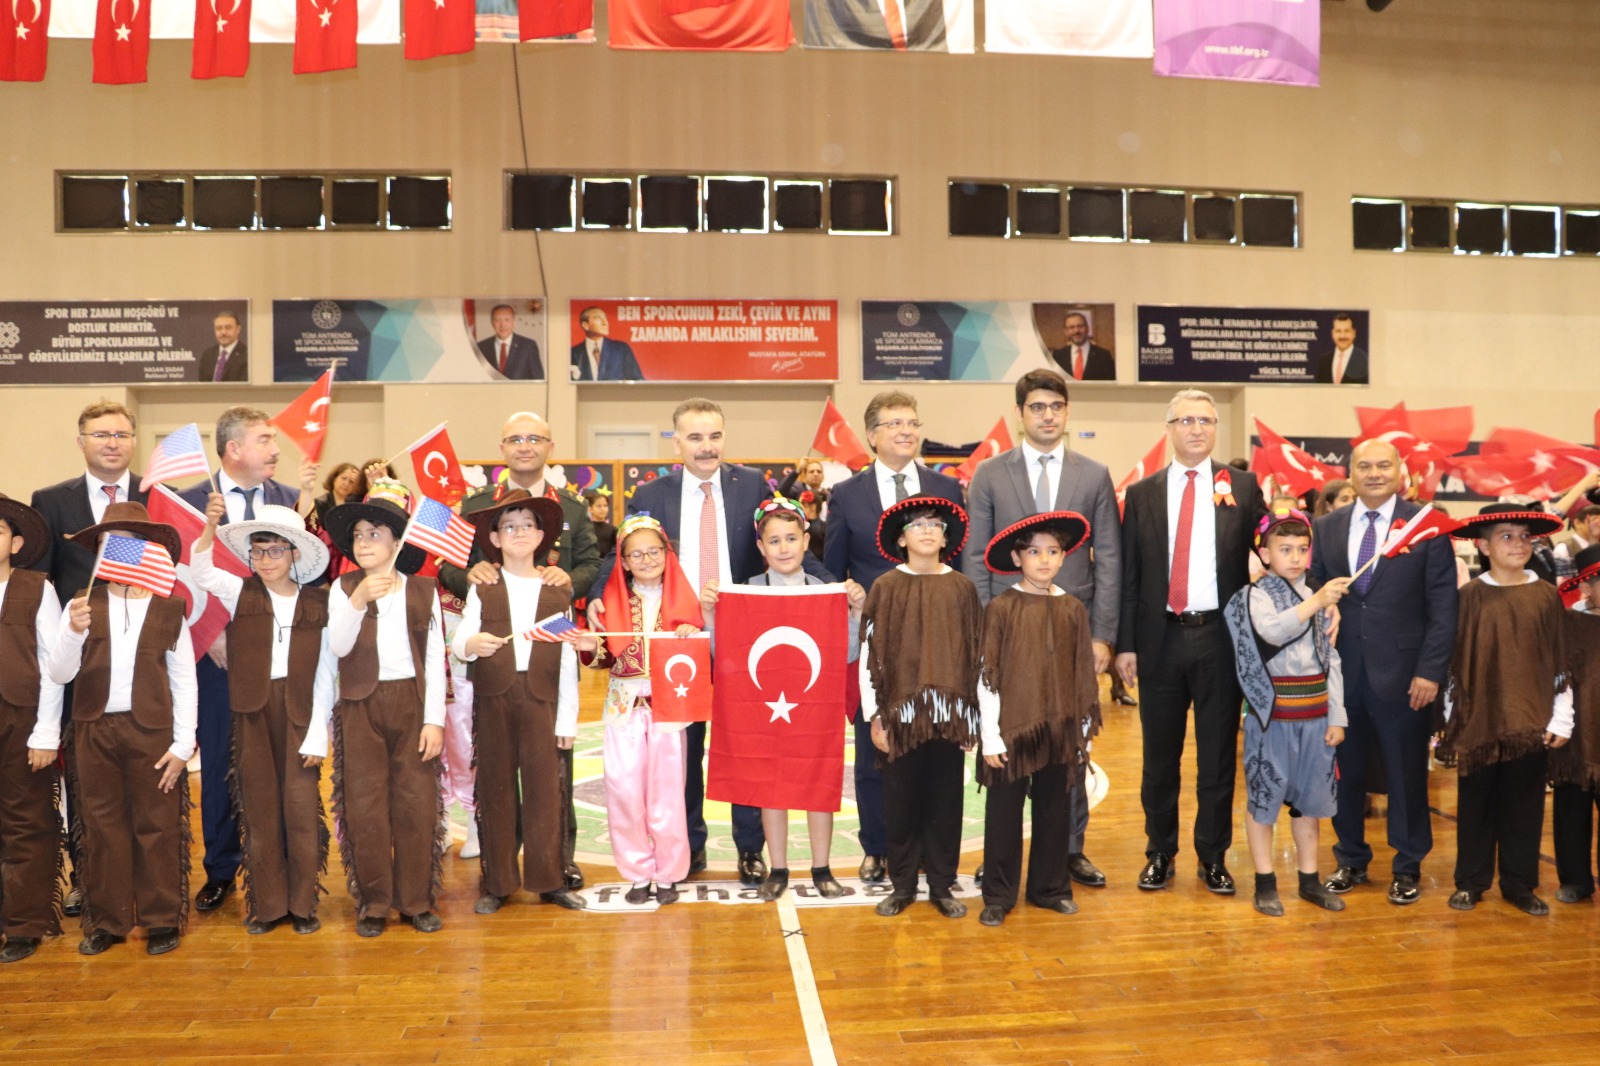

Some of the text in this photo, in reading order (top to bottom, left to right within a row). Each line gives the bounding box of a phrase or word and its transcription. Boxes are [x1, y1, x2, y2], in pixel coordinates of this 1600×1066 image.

[45, 305, 179, 320] SPOR HER ZAMAN HOŞGÖRÜ VE
[617, 302, 831, 325] BEN SPORCUNUN ZEKİ, ÇEVİK VE AYNI
[68, 320, 156, 333] DOSTLUK DEMEKTİR.
[1263, 319, 1272, 328] VE
[630, 323, 818, 342] ZAMANDA AHLAKLISINI SEVERİM.
[1234, 329, 1261, 339] KATILAN
[52, 335, 173, 348] BÜTÜN SPORCULARIMIZA VE
[1244, 341, 1253, 350] VE
[29, 348, 196, 364] GÖREVLİLERİMİZE BAŞARILAR DİLERİM.
[1244, 351, 1280, 362] BAŞARILAR
